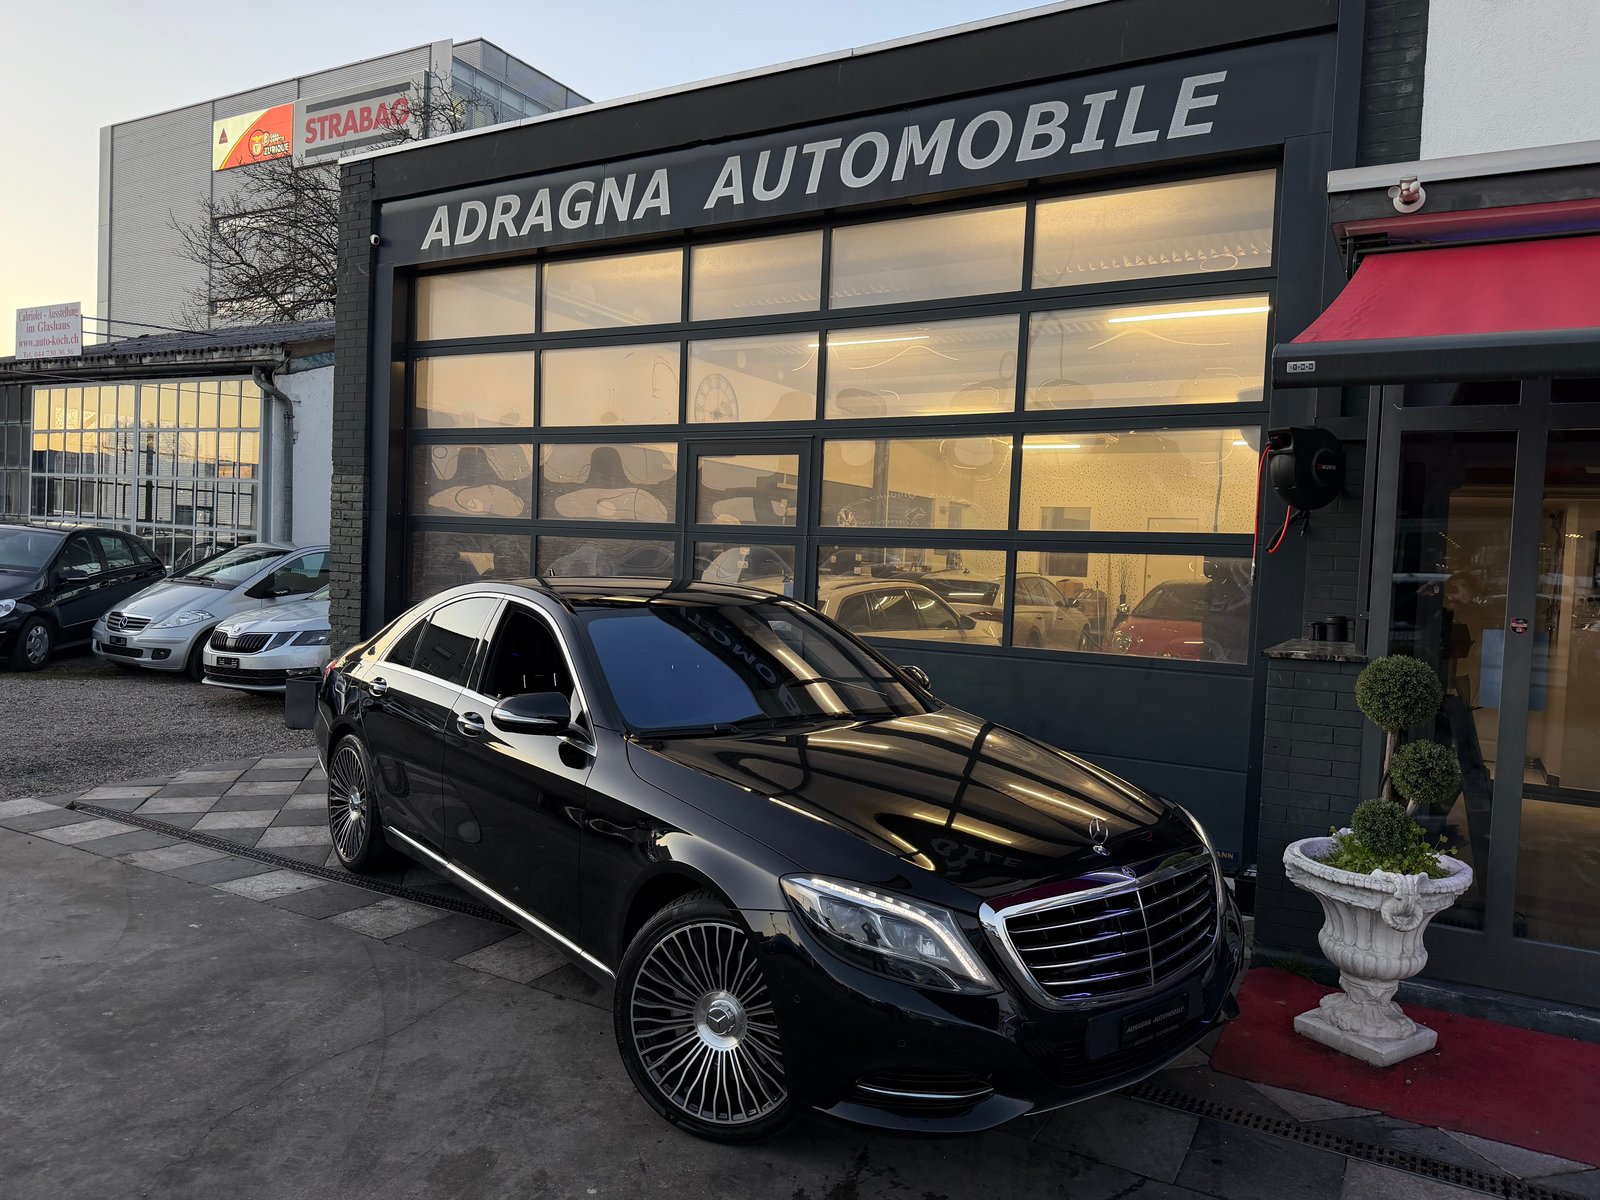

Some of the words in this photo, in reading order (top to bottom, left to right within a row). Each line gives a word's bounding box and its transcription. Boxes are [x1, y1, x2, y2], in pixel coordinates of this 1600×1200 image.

[305, 97, 411, 144] STRABAG
[421, 168, 672, 250] ADRAGNA
[703, 70, 1228, 210] AUTOMOBILE
[18, 310, 43, 322] Cabriolet
[48, 307, 79, 319] Ausstellung
[26, 323, 35, 333] im
[37, 321, 71, 332] Glashaus
[18, 334, 79, 347] www.auto-koch.ch
